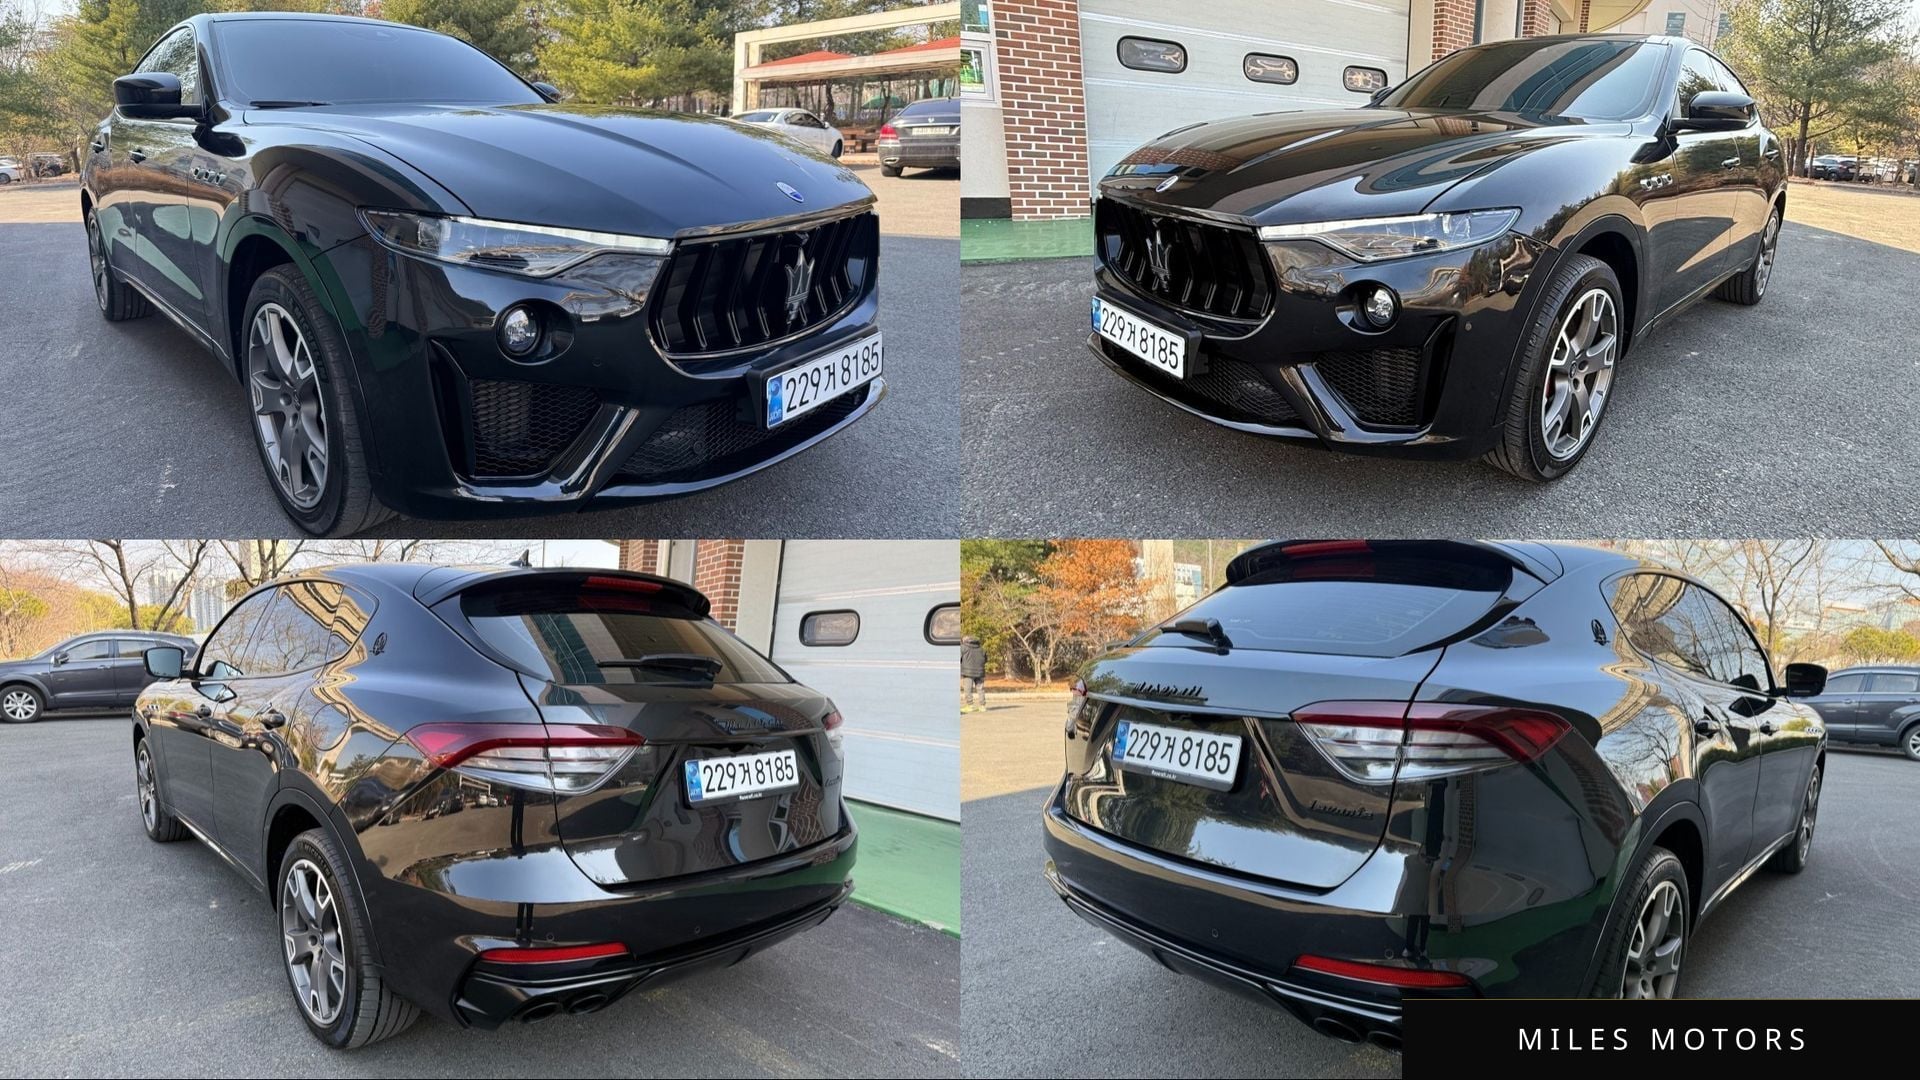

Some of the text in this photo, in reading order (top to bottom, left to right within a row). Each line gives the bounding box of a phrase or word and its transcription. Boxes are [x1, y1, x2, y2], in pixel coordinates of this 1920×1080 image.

[1102, 307, 1178, 369] 229거 8185
[785, 341, 879, 413] 229거 8185
[703, 755, 794, 793] 229거 8185
[1126, 729, 1233, 775] 229거 8185
